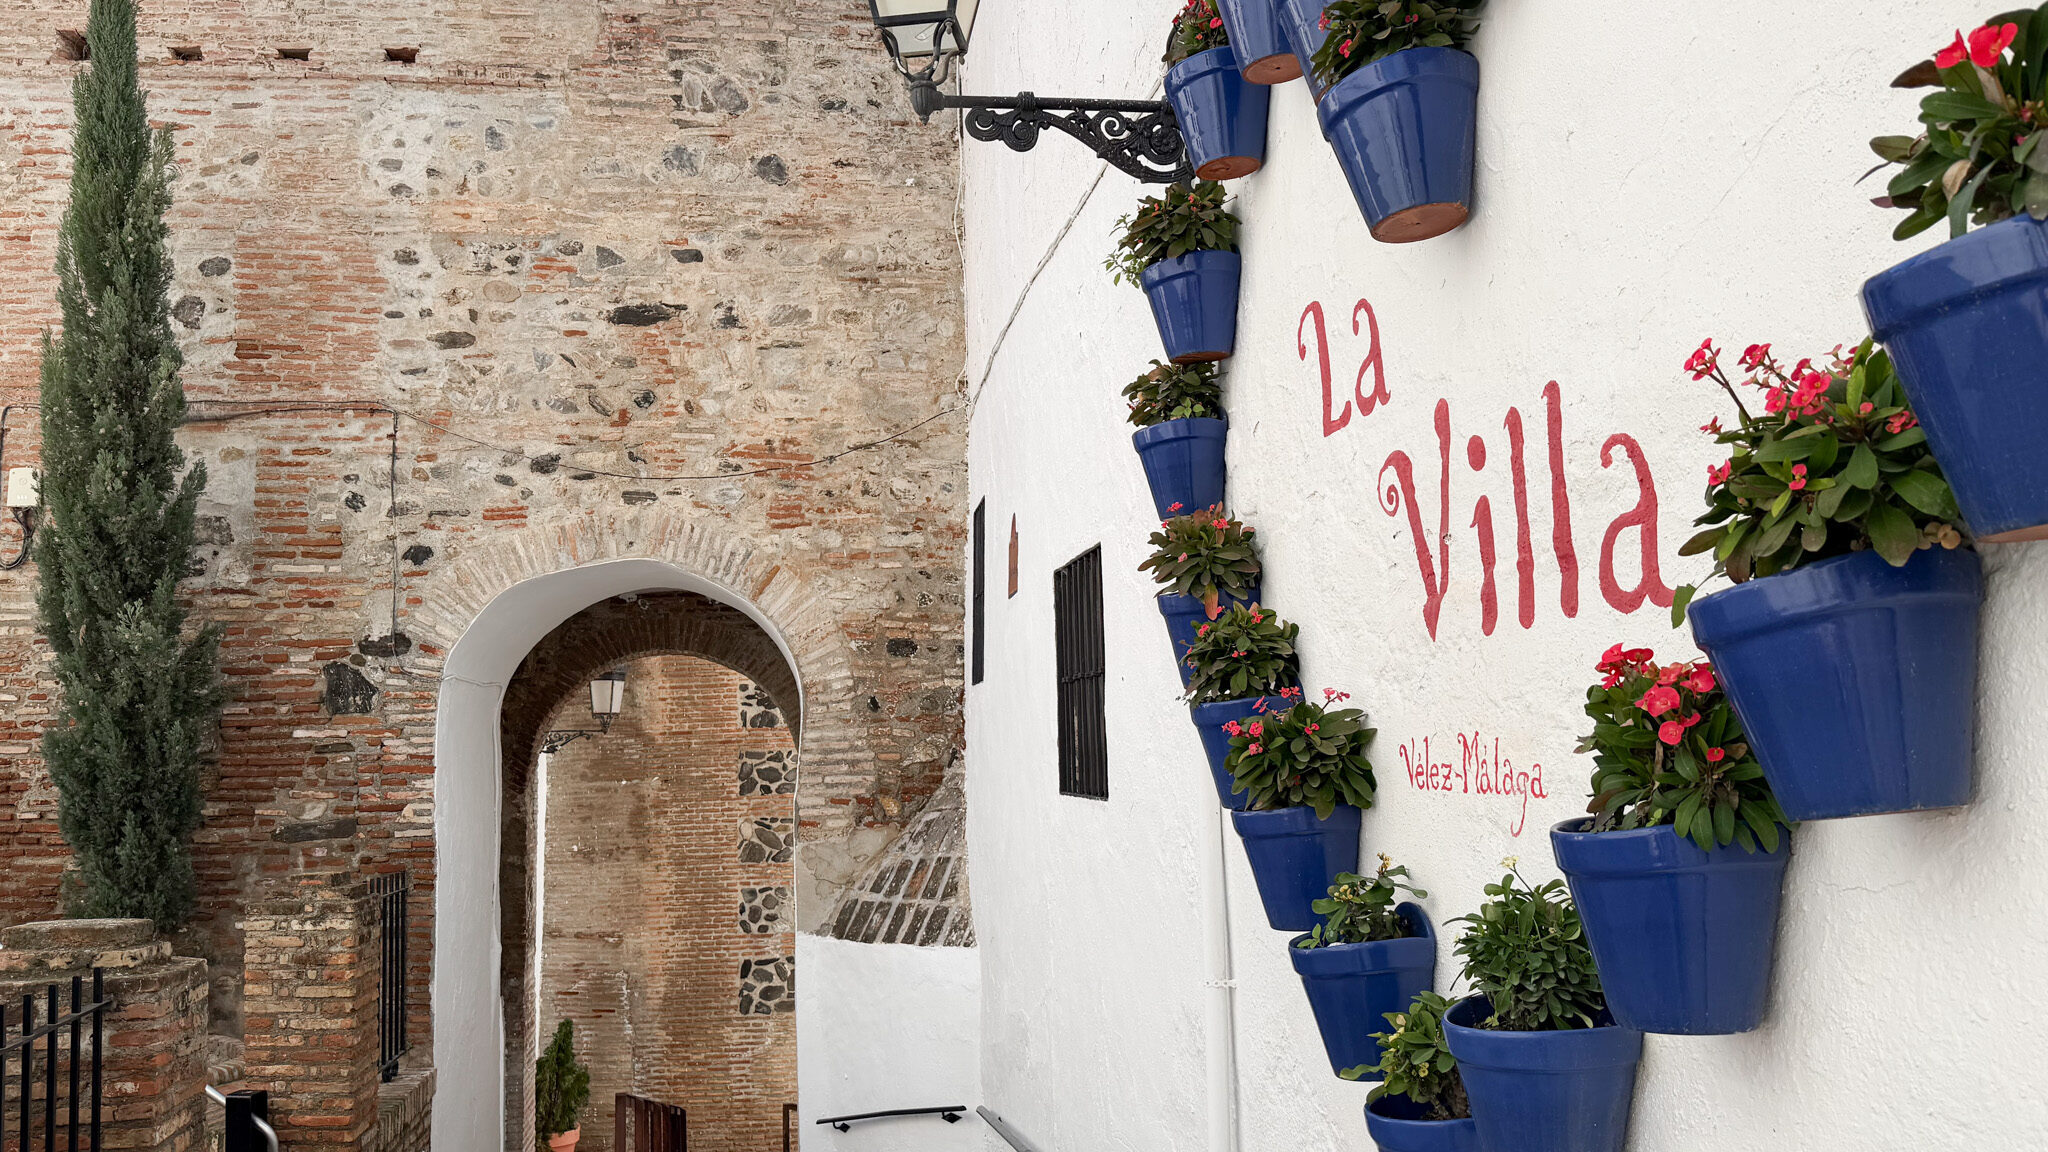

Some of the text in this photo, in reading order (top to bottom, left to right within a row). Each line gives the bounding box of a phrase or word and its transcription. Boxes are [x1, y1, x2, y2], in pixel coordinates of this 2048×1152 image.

[1297, 298, 1391, 438] La
[1377, 380, 1677, 642] Villa
[1399, 730, 1548, 838] Vélez-Málaga
